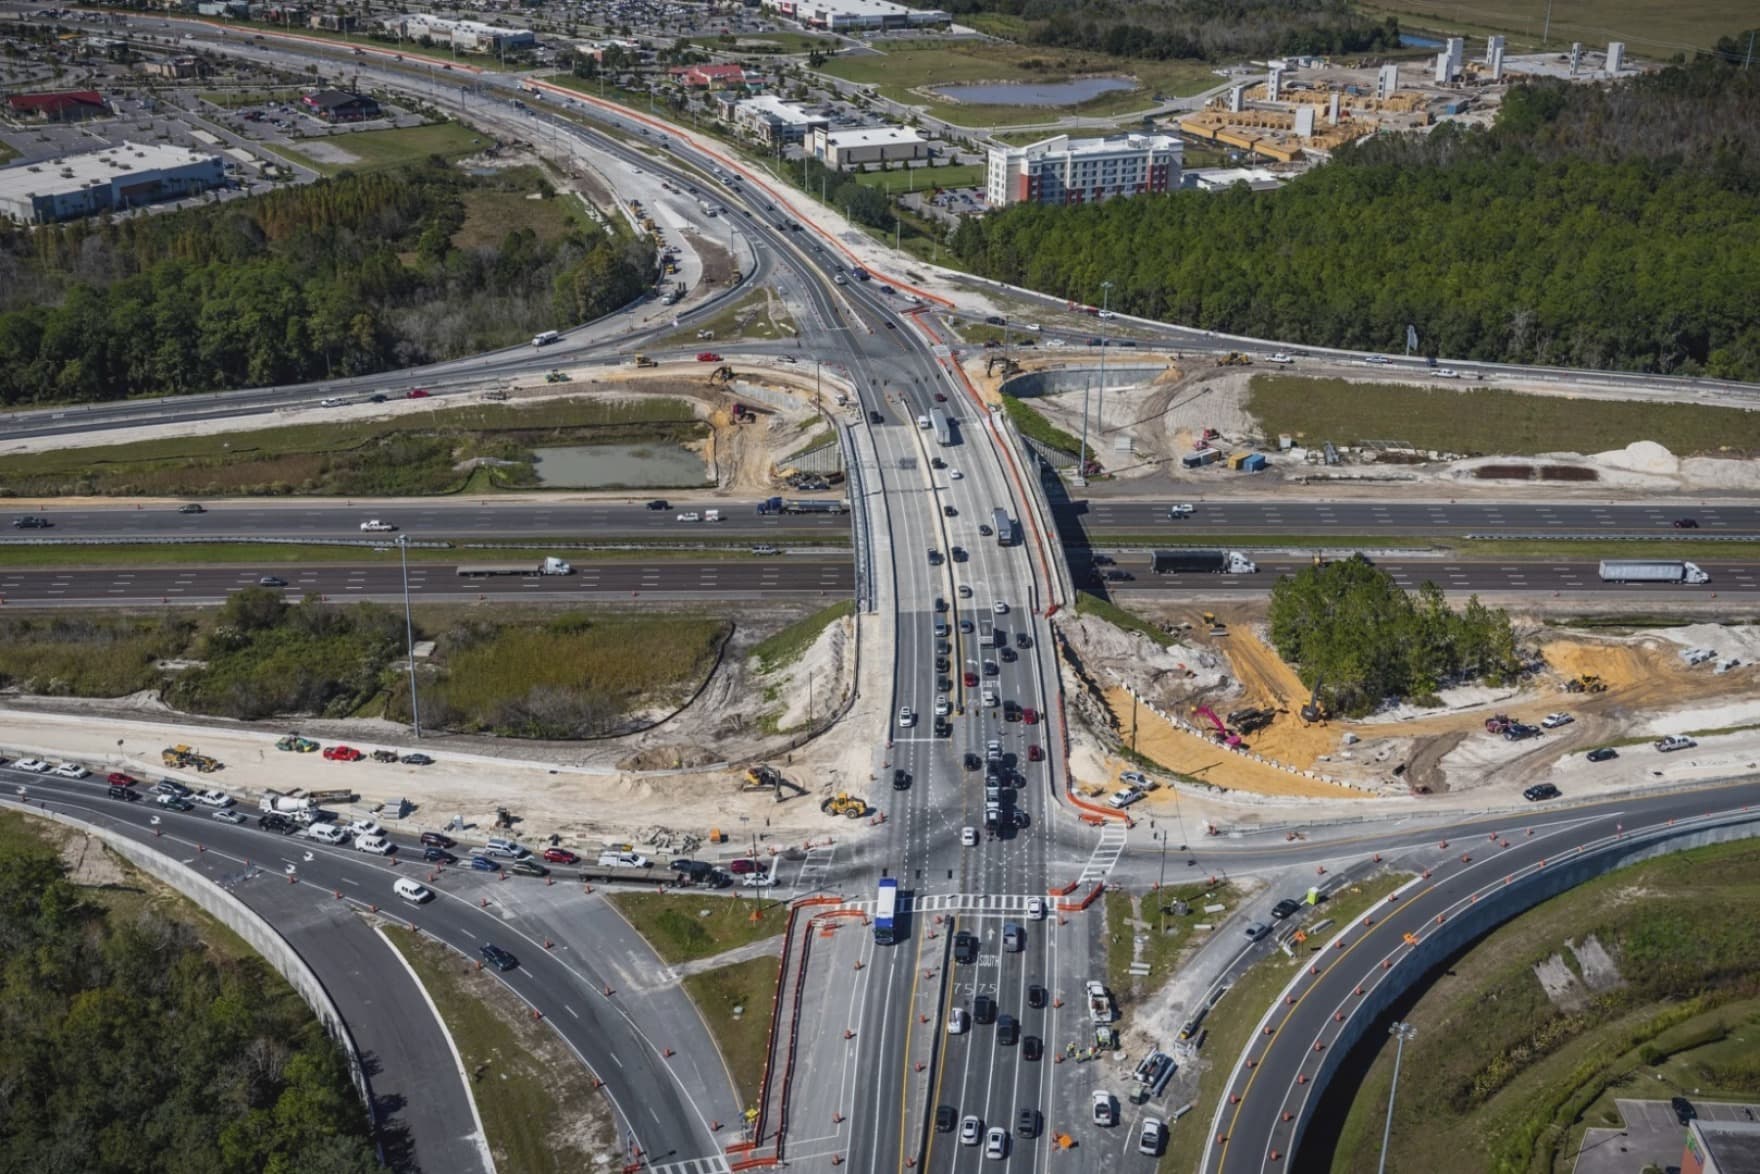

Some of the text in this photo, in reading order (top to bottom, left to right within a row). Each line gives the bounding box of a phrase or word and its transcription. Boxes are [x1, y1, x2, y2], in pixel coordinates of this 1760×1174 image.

[979, 954, 999, 968] SOUTH
[954, 983, 974, 996] 75
[979, 983, 997, 994] 75
